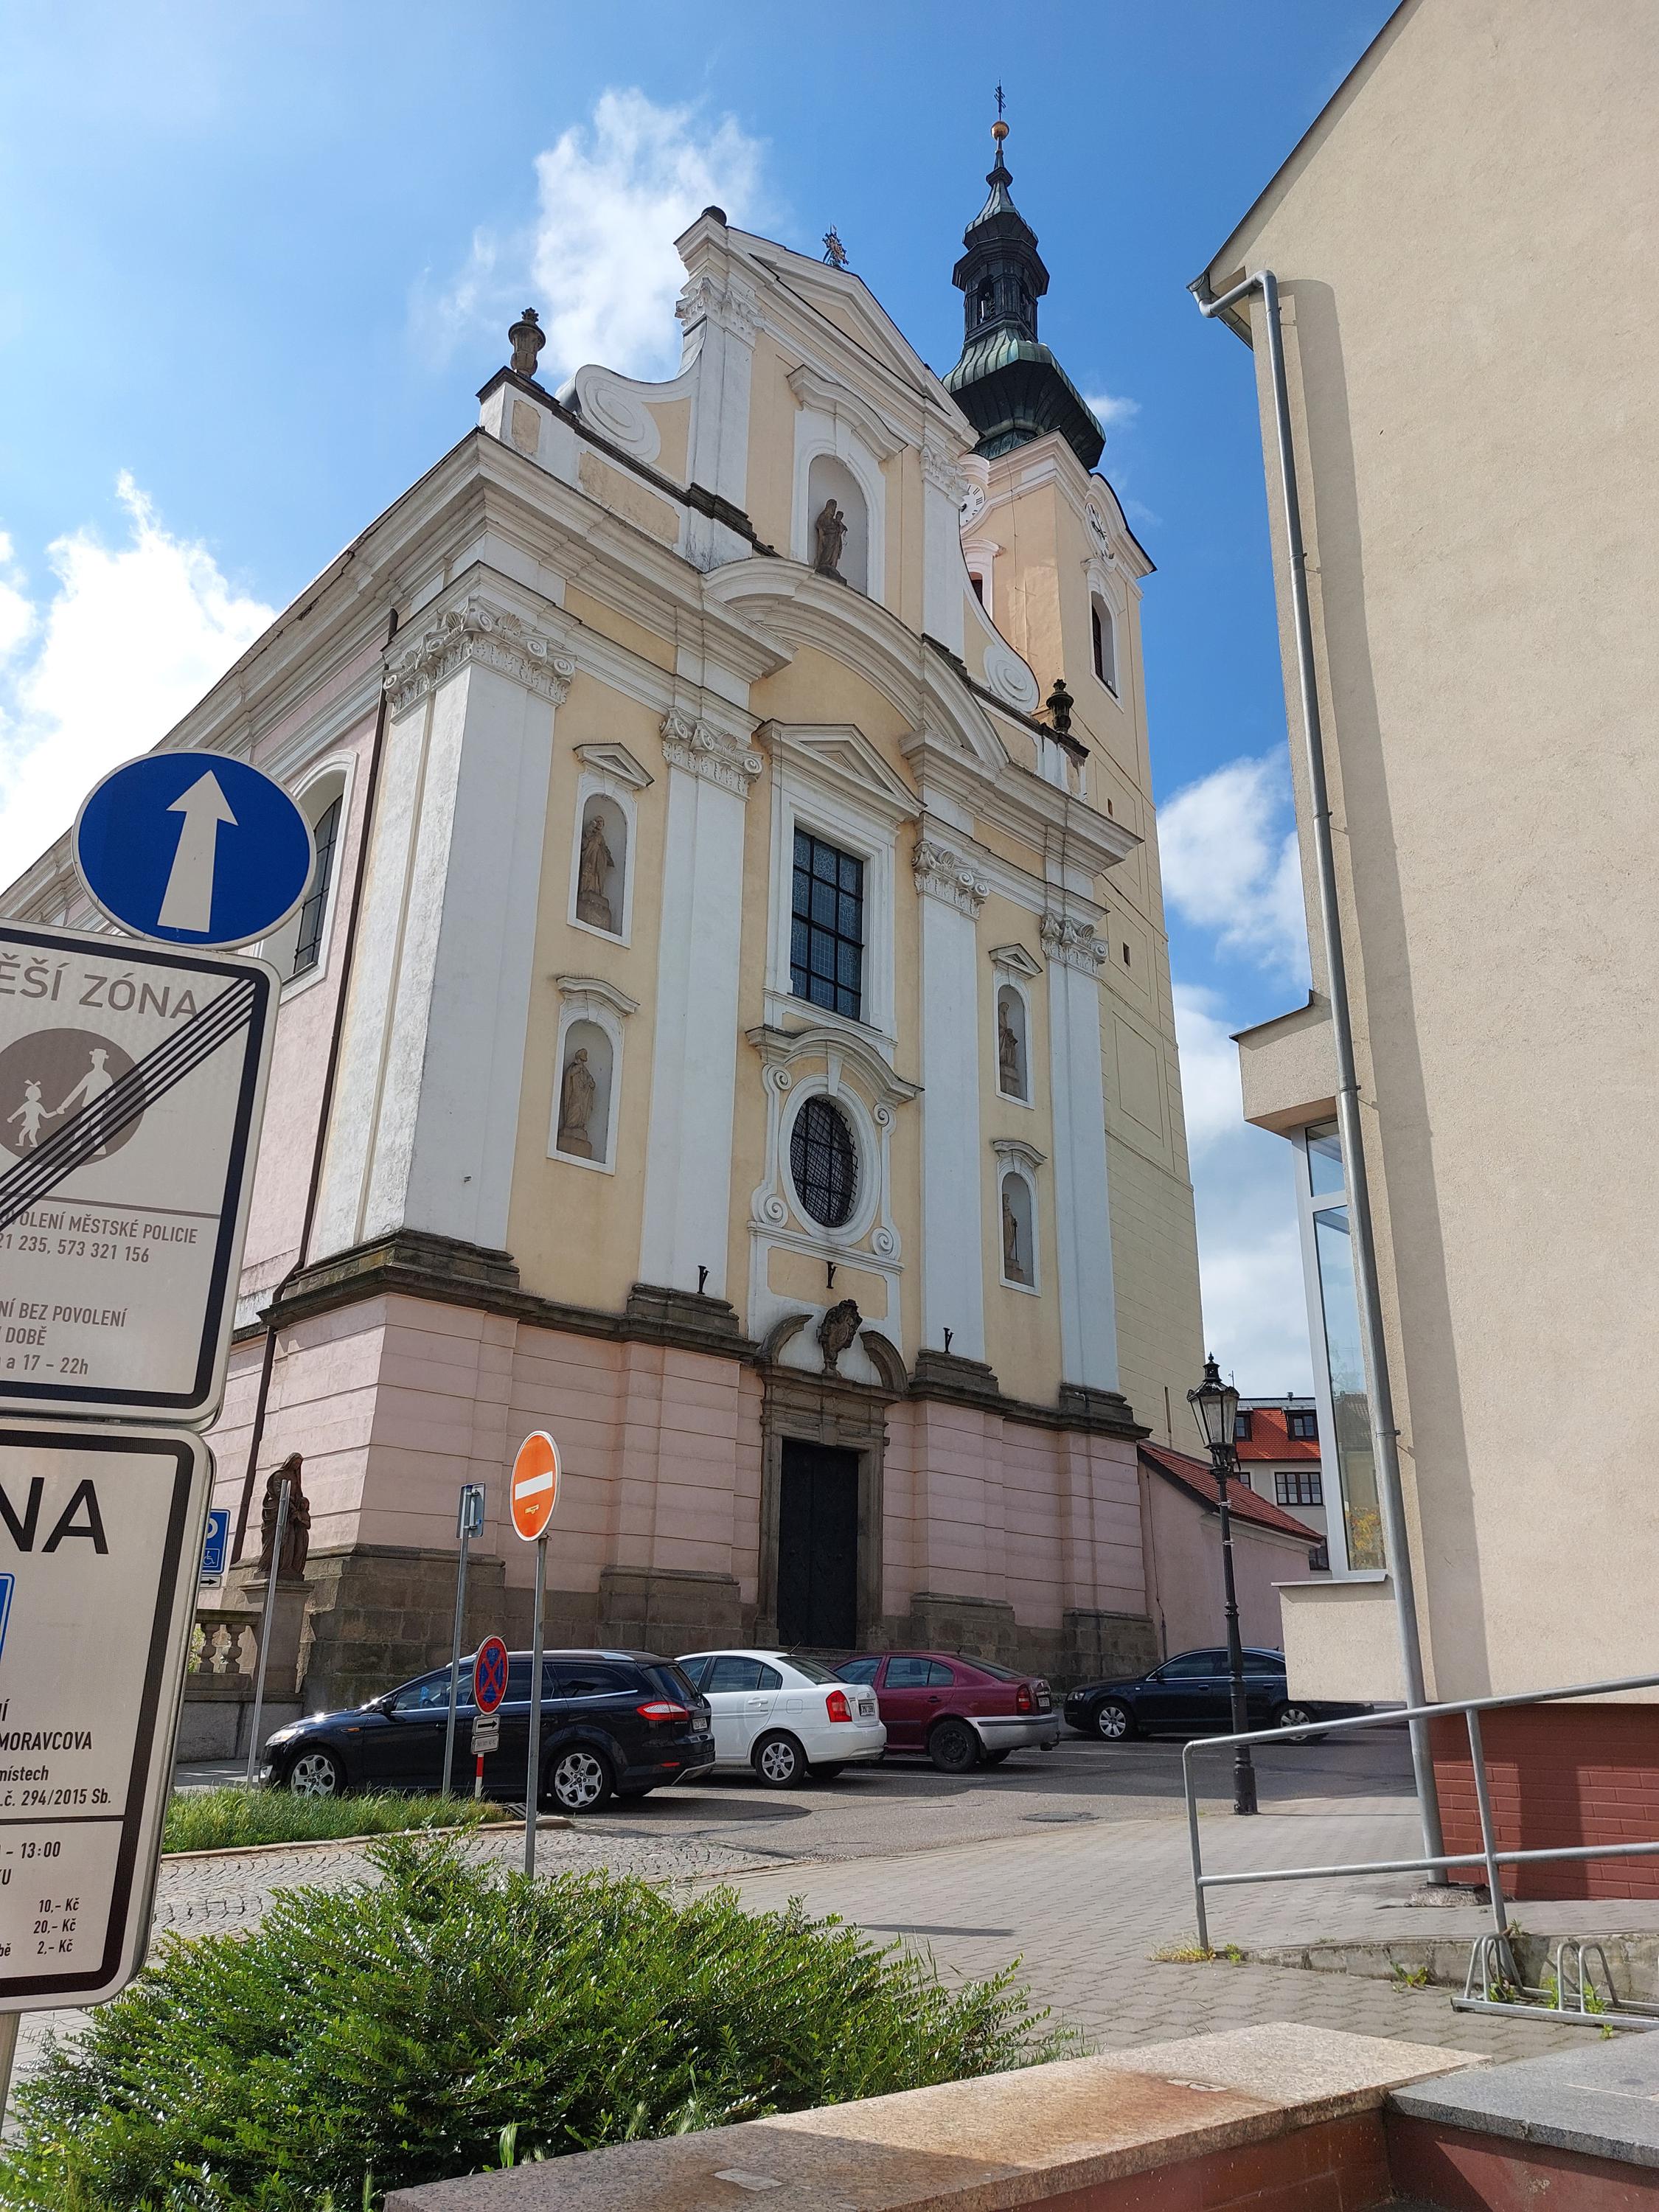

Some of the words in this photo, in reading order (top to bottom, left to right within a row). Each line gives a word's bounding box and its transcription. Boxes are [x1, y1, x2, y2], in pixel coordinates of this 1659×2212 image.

[78, 972, 200, 1022] ZÓNA
[69, 1214, 139, 1238] MĚSTSKÉ
[142, 1223, 198, 1244] POLICIE
[18, 1234, 51, 1255] 235,
[57, 1239, 85, 1256] 573
[91, 1242, 117, 1259] 321
[125, 1246, 150, 1263] 156
[19, 1302, 49, 1321] BEZ
[52, 1305, 128, 1326] POVOLENÍ
[5, 1326, 47, 1346] DOBĚ
[6, 1358, 15, 1369] a
[23, 1354, 41, 1371] 17
[60, 1357, 89, 1375] 22h
[21, 1788, 88, 1806] 294/2015
[91, 1788, 111, 1804] Sb.
[21, 1840, 61, 1859] 13:00
[65, 1897, 80, 1912] Kč
[62, 1918, 77, 1933] Kč
[58, 1938, 74, 1953] Kč
